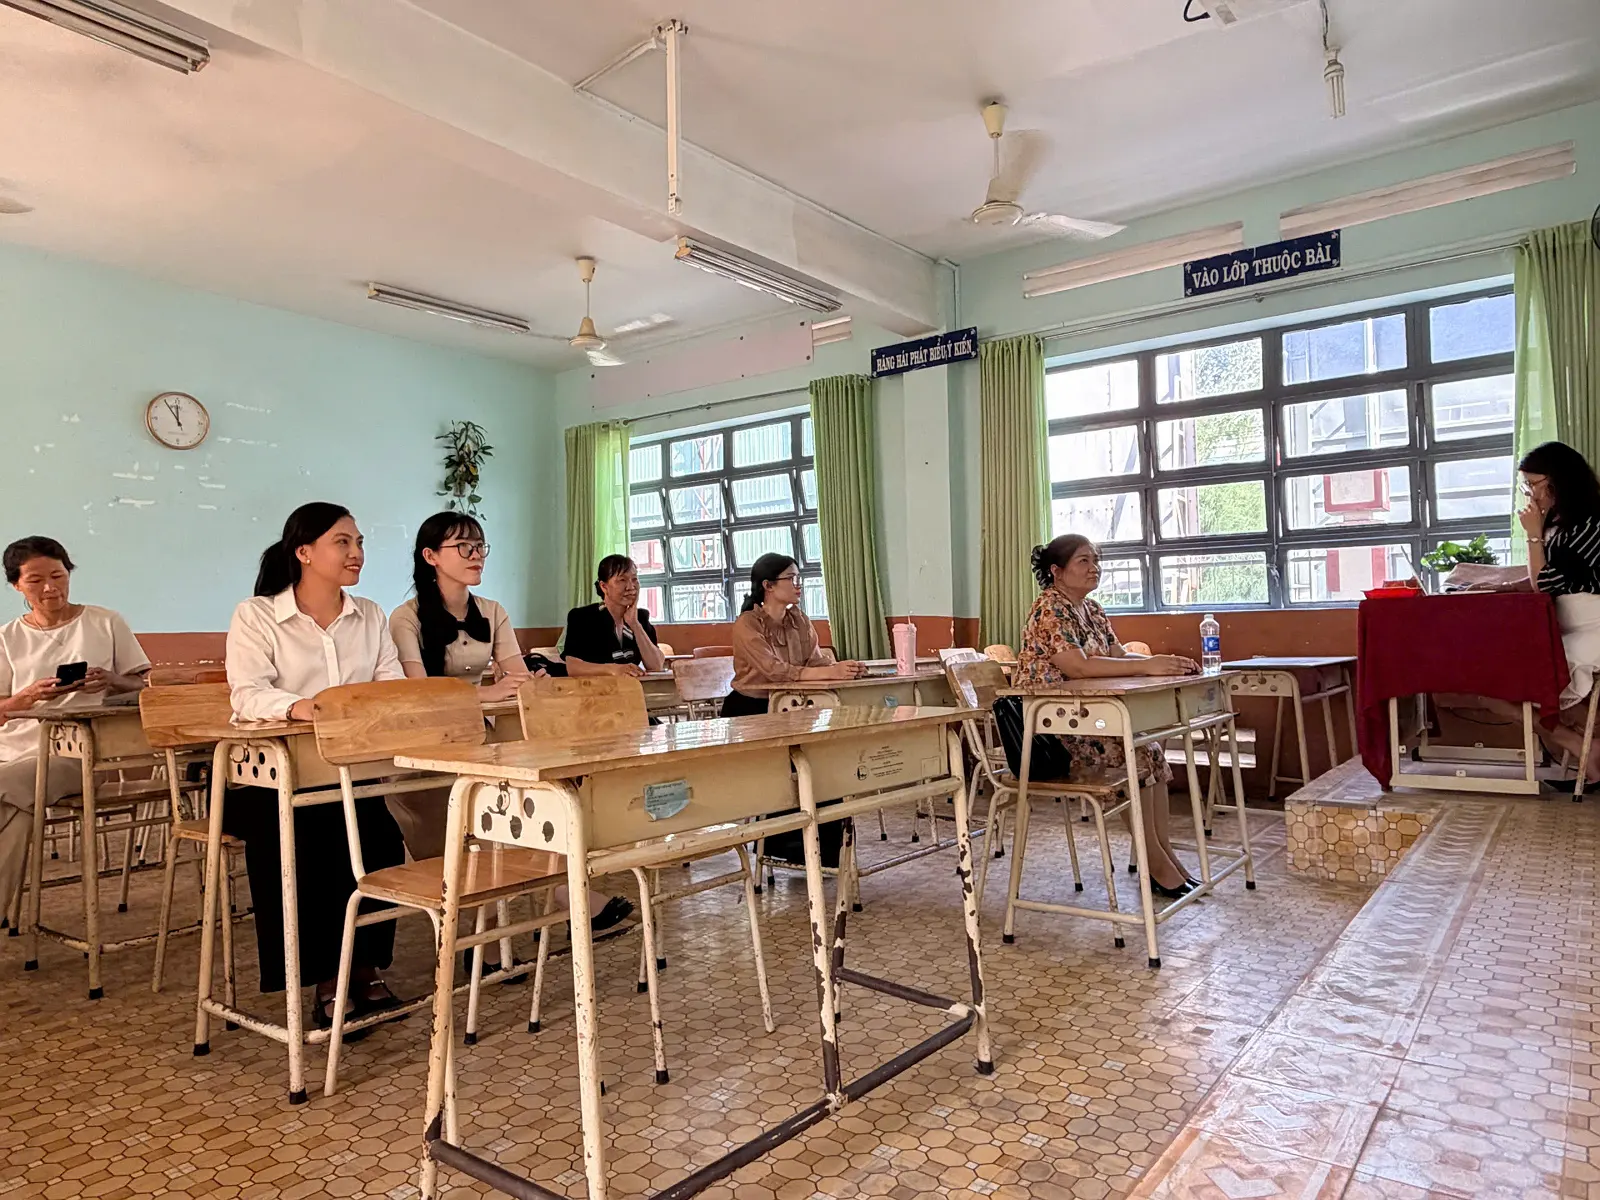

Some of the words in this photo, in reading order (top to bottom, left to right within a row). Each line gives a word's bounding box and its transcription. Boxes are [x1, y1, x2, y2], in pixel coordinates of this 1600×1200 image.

[1192, 266, 1219, 289] VÀO
[1223, 260, 1249, 283] LỚP
[1252, 249, 1301, 276] THUỘC
[1305, 242, 1331, 266] BÀI
[896, 350, 909, 368] HÁI
[910, 346, 928, 365] PHÁT
